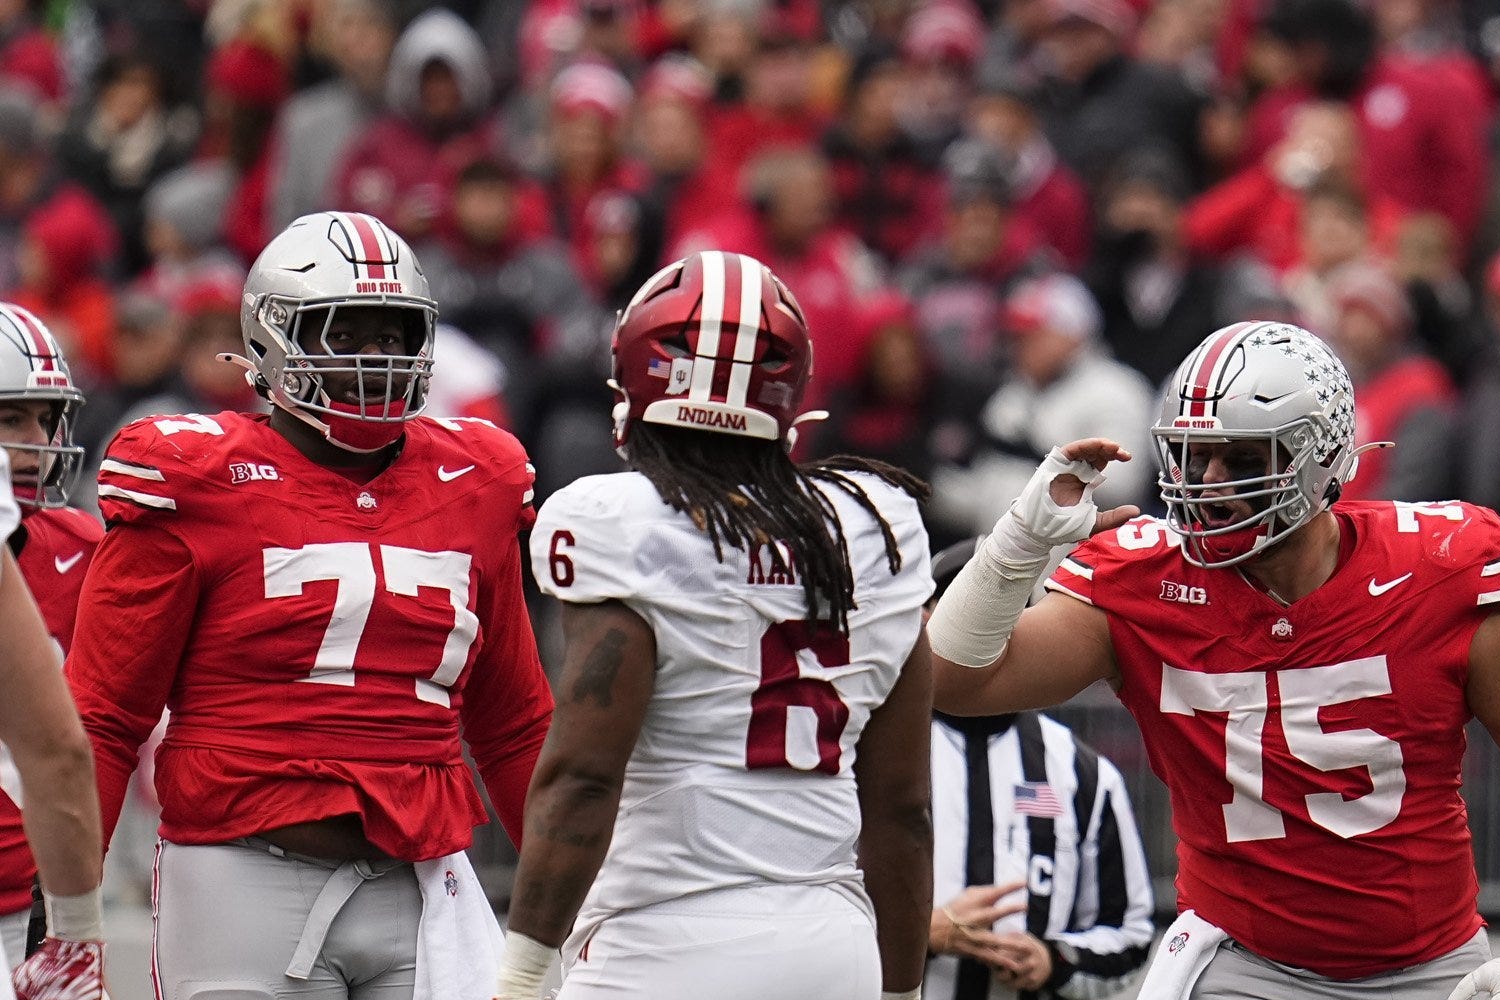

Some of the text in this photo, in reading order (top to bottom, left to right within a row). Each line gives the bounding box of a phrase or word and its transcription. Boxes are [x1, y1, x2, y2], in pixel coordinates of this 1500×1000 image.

[356, 282, 403, 294] OHIO STATE
[676, 406, 747, 431] INDIANA
[548, 529, 576, 588] 6
[263, 541, 479, 709] 77
[745, 618, 851, 777] 6
[1159, 654, 1407, 844] 75
[1029, 854, 1054, 897] C
